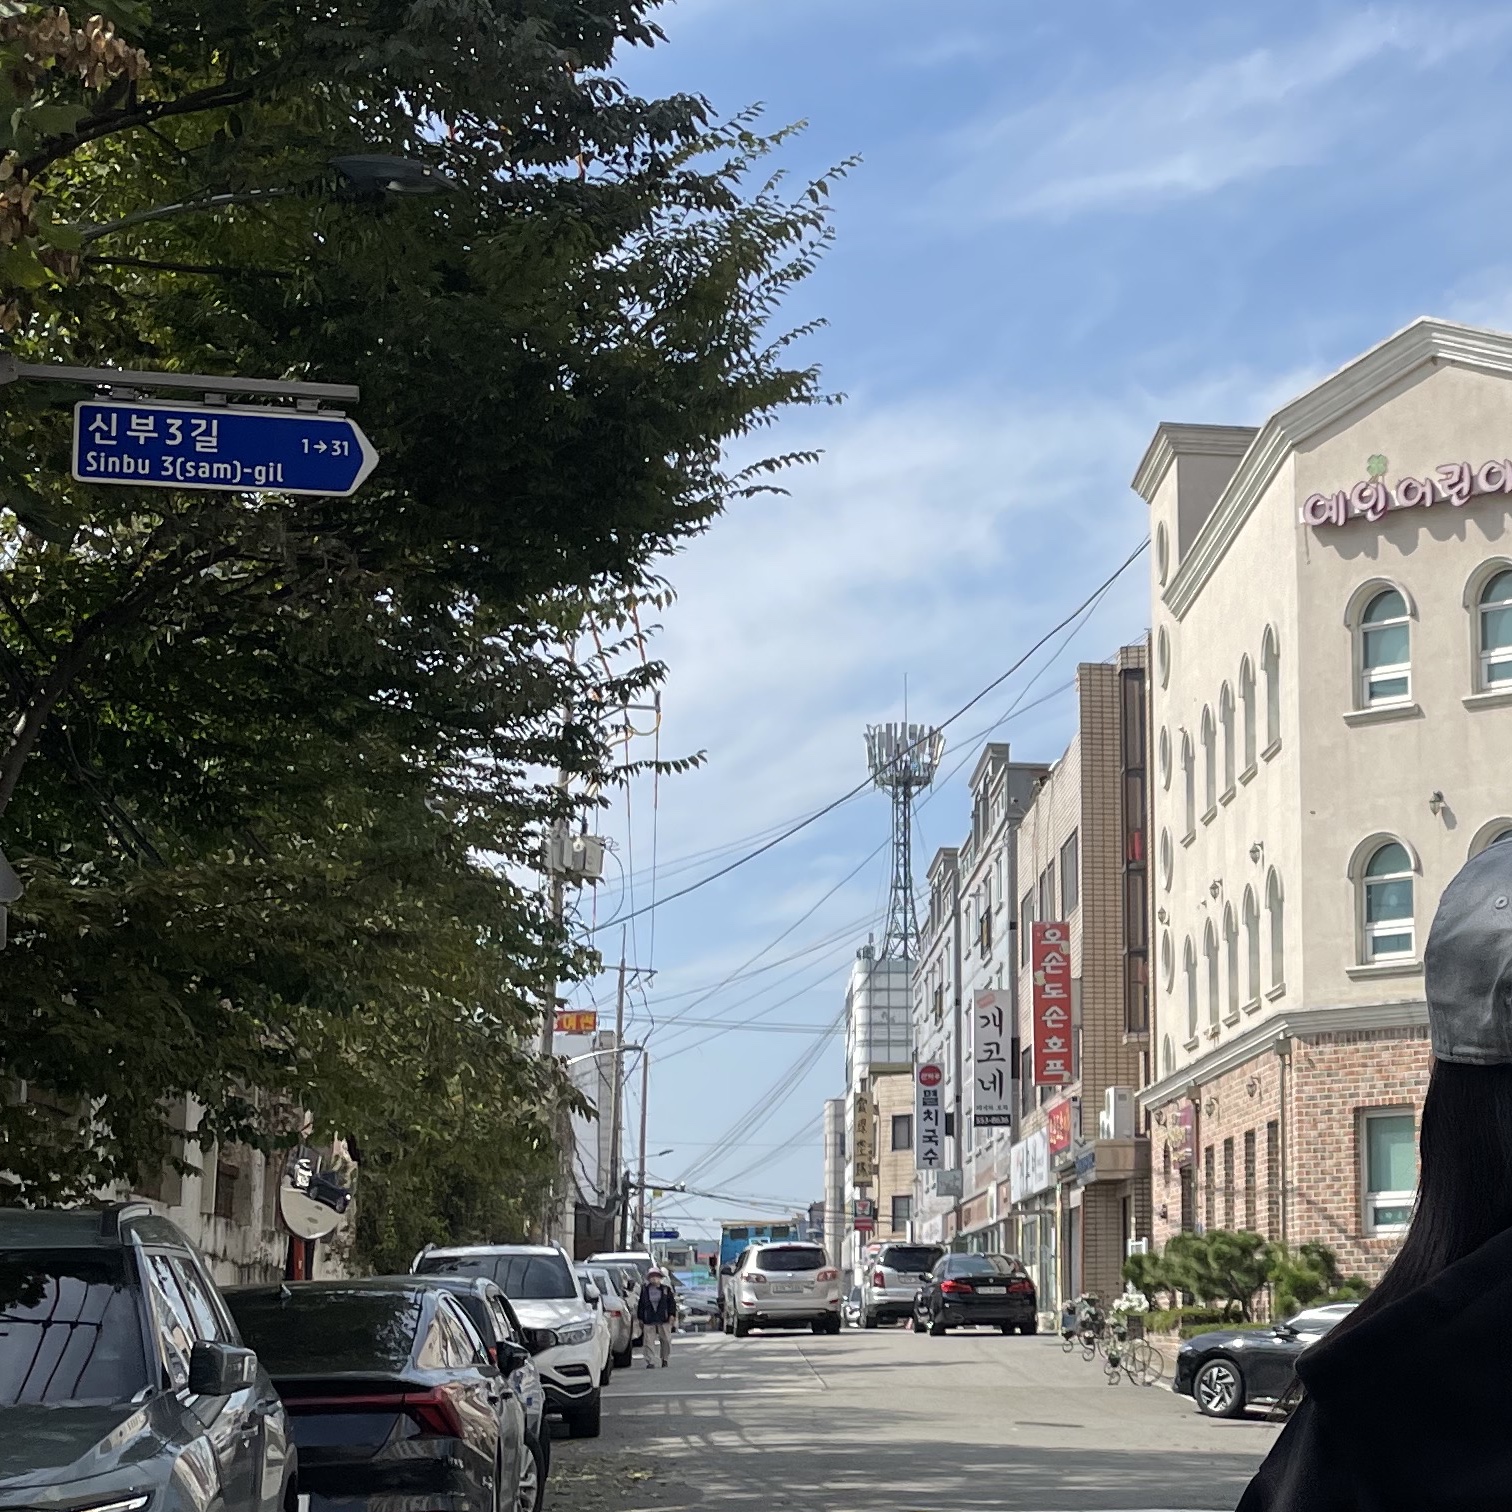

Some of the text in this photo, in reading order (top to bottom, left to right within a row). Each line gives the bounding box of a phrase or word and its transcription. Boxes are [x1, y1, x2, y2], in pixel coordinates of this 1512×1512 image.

[88, 413, 219, 453] 신부3길
[86, 451, 284, 486] Sinbu 3(sam)-gil
